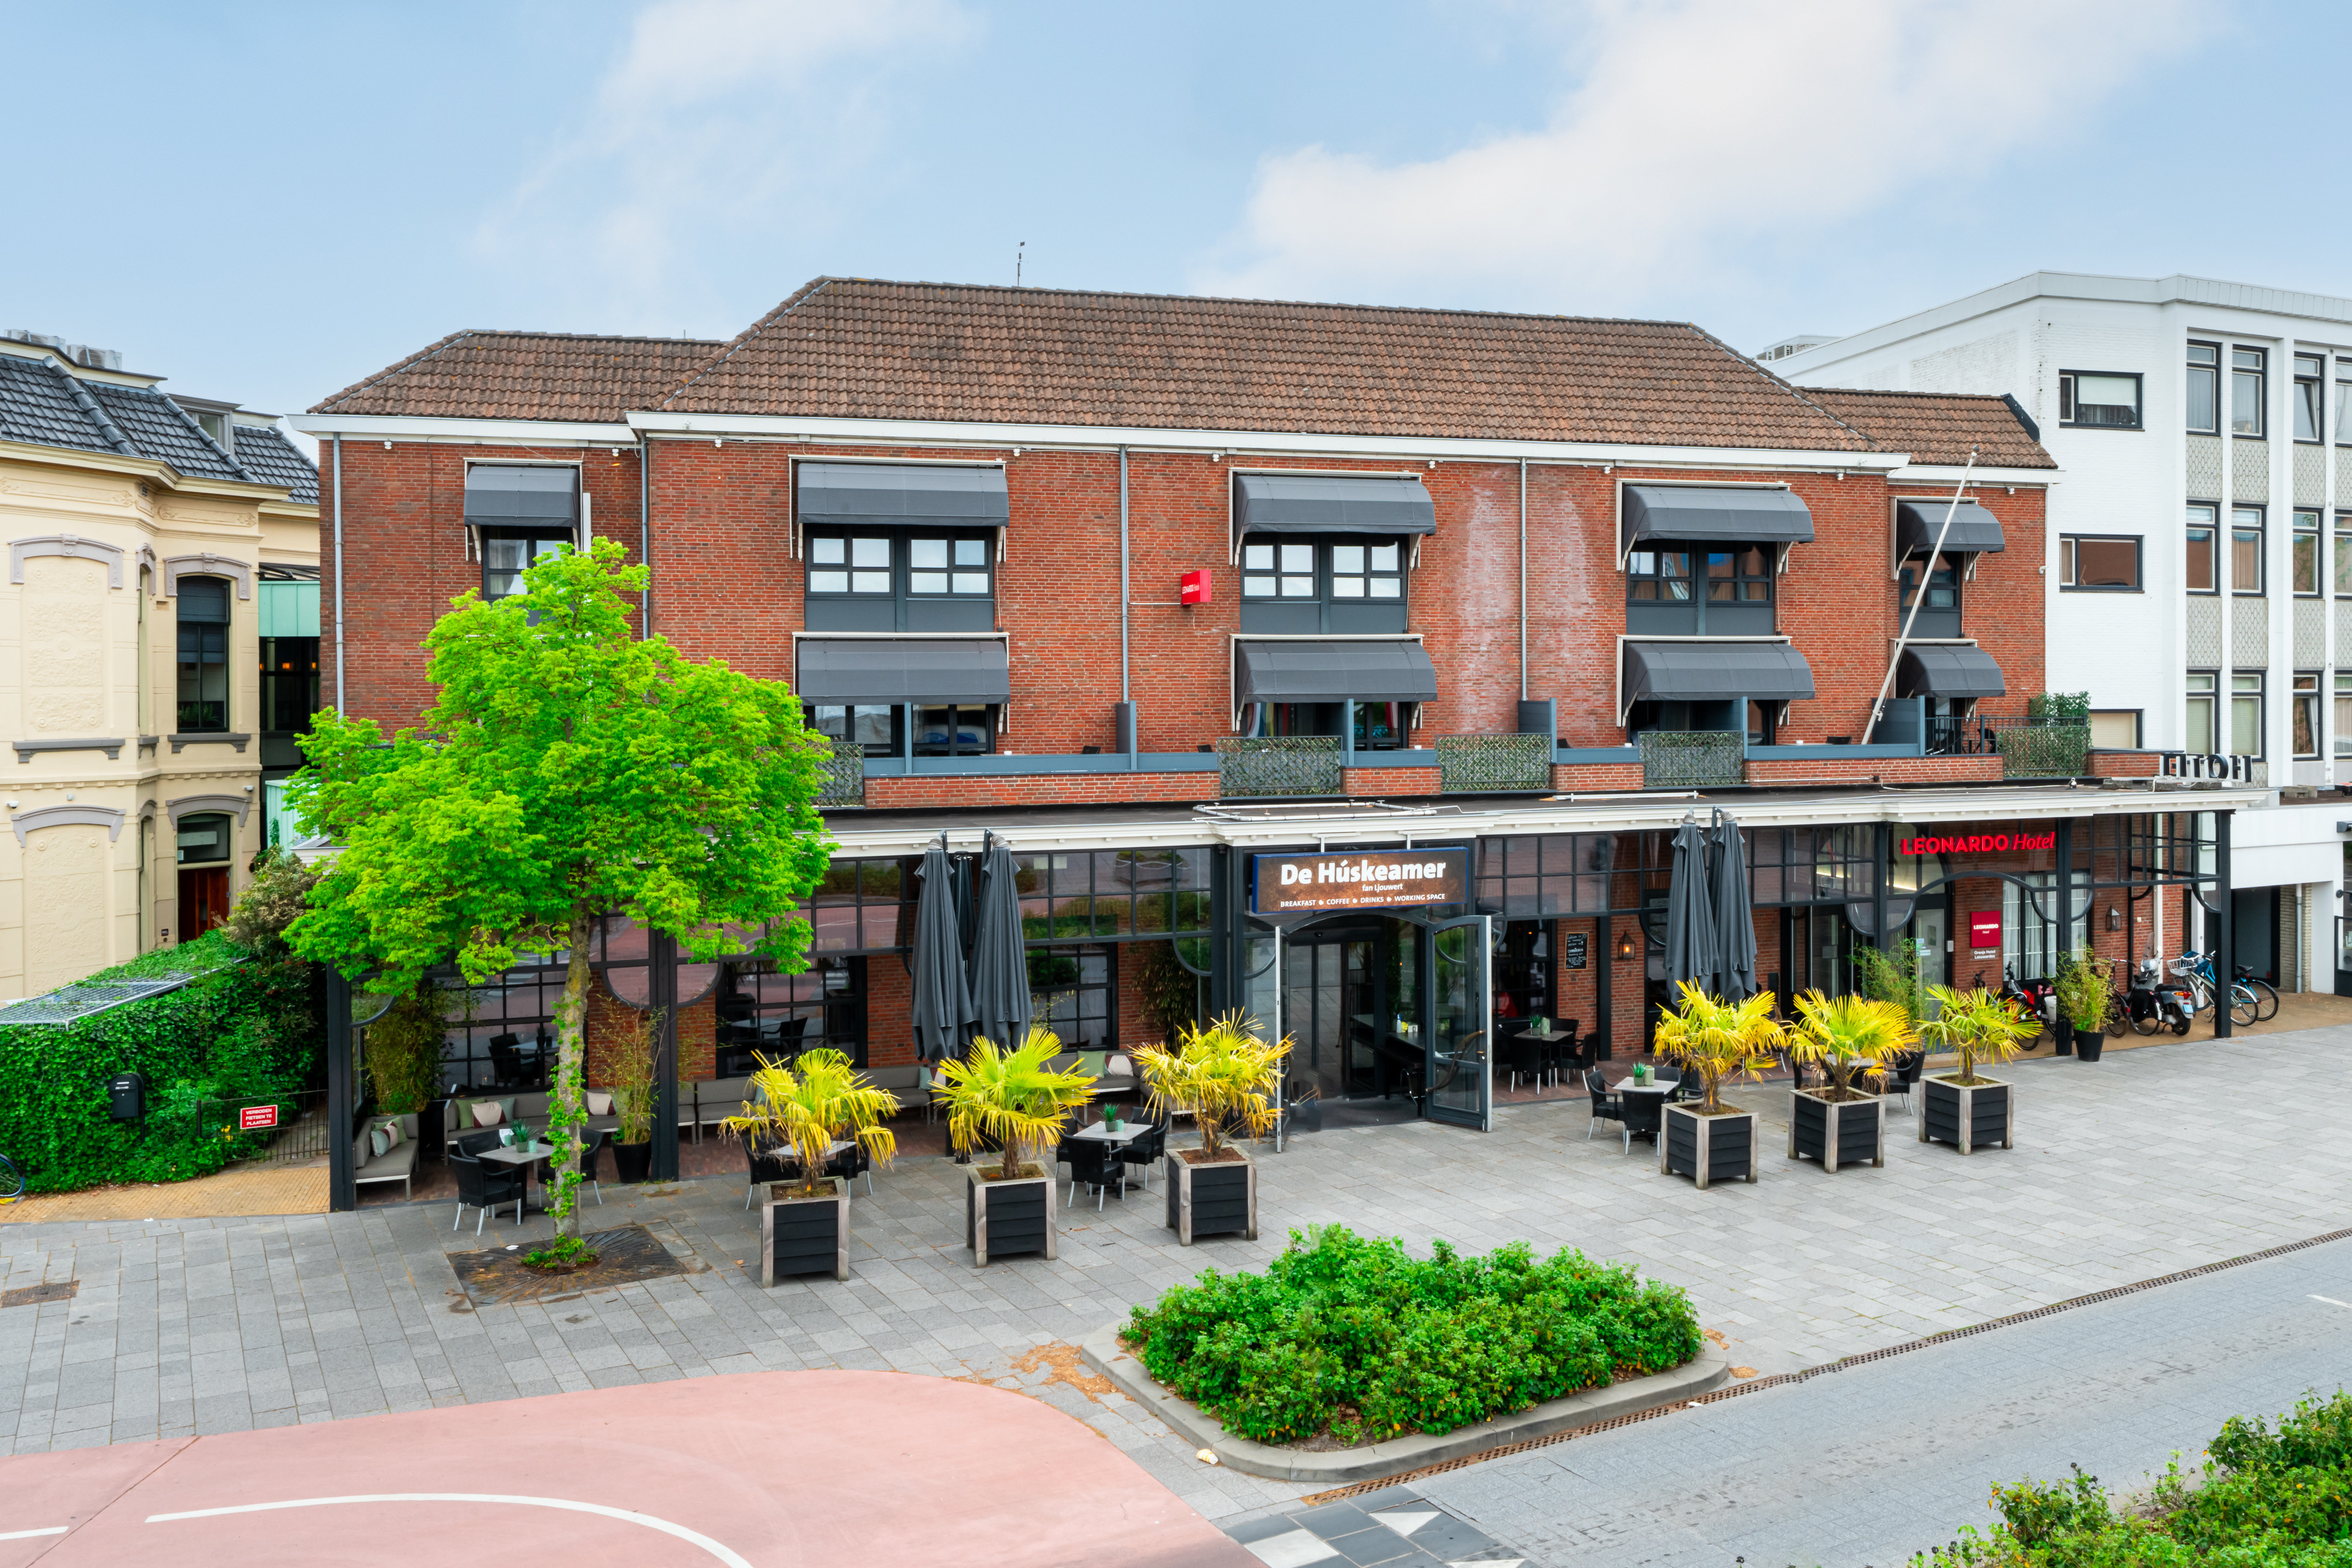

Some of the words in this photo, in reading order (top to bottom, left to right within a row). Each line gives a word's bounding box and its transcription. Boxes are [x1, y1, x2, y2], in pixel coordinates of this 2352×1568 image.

[1901, 835, 2008, 854] LEONARDO
[2011, 832, 2055, 850] Hotel
[1281, 864, 1312, 885] De
[1318, 859, 1446, 883] Húskeamer
[1374, 883, 1403, 892] Ljouwert
